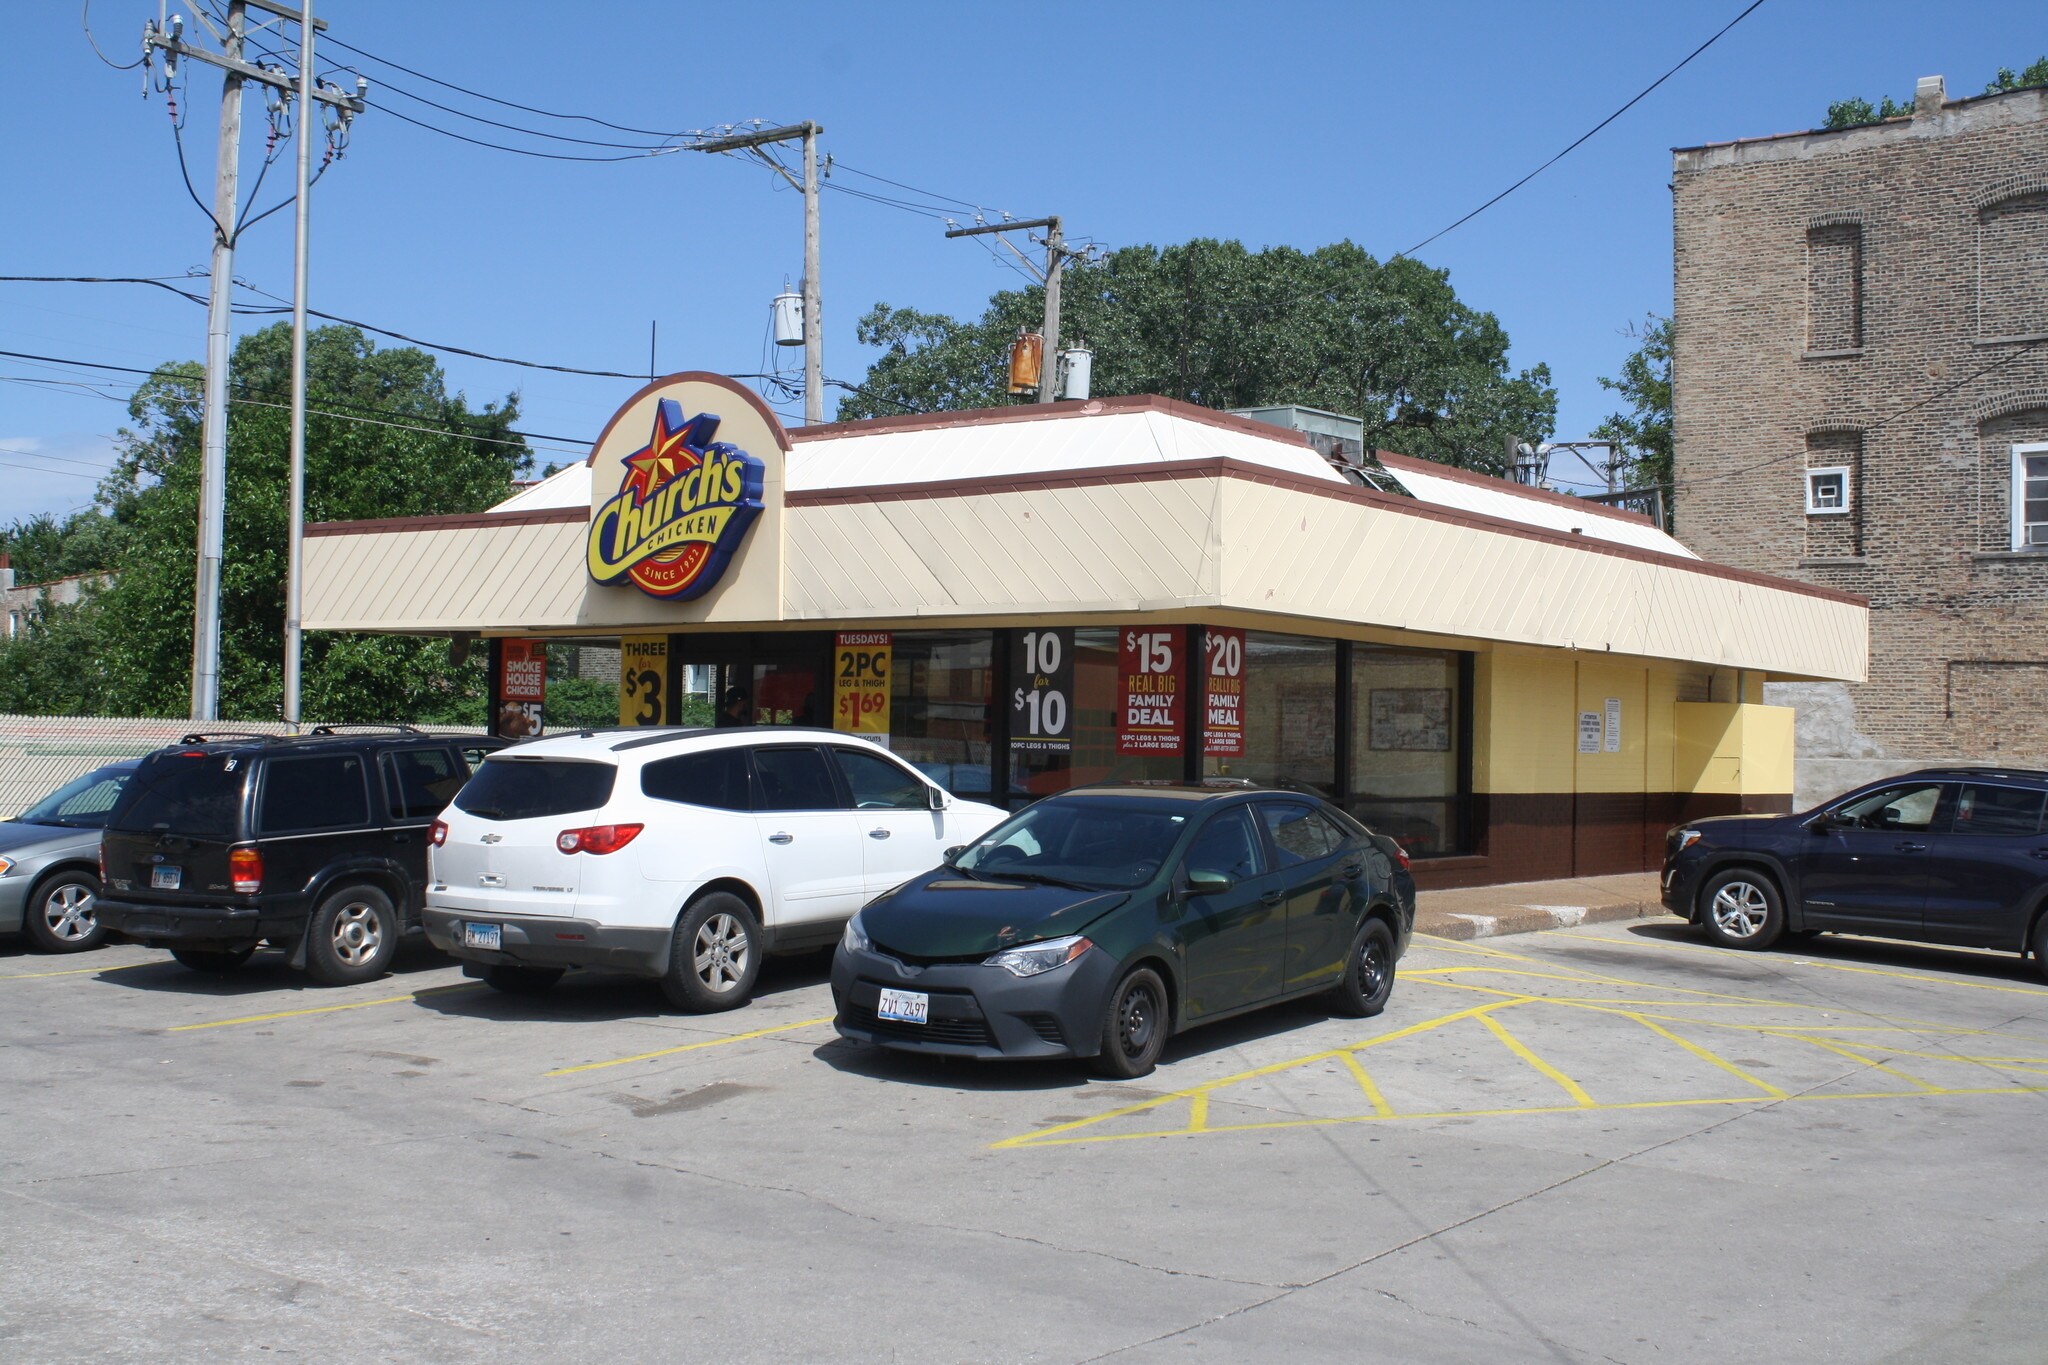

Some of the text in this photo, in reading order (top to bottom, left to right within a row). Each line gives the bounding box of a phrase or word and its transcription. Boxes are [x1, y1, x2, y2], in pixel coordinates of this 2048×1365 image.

[587, 450, 743, 581] Church's
[647, 514, 718, 551] CHICKEN
[644, 547, 699, 581] SINCE 1952
[840, 634, 888, 644] TUESDAYS!
[625, 642, 666, 656] THREE
[1023, 632, 1061, 674] 10
[1127, 631, 1172, 673] $15
[1205, 631, 1241, 677] $20
[506, 660, 541, 673] SMOKE
[840, 652, 886, 678] 2PC
[506, 673, 541, 686] HOUSE
[1033, 674, 1050, 689] for
[1128, 675, 1176, 693] REAL BIG
[1208, 677, 1240, 694] REALLY BIG
[505, 685, 541, 695] CHICKEN
[626, 668, 662, 726] $3
[1128, 694, 1175, 707] FAMILY
[1208, 694, 1240, 708] FAMILY
[522, 702, 543, 736] $5
[1014, 687, 1067, 735] $10
[1127, 708, 1174, 725] DEAL
[1208, 709, 1240, 726] MEAL
[903, 1001, 926, 1018] 2497
